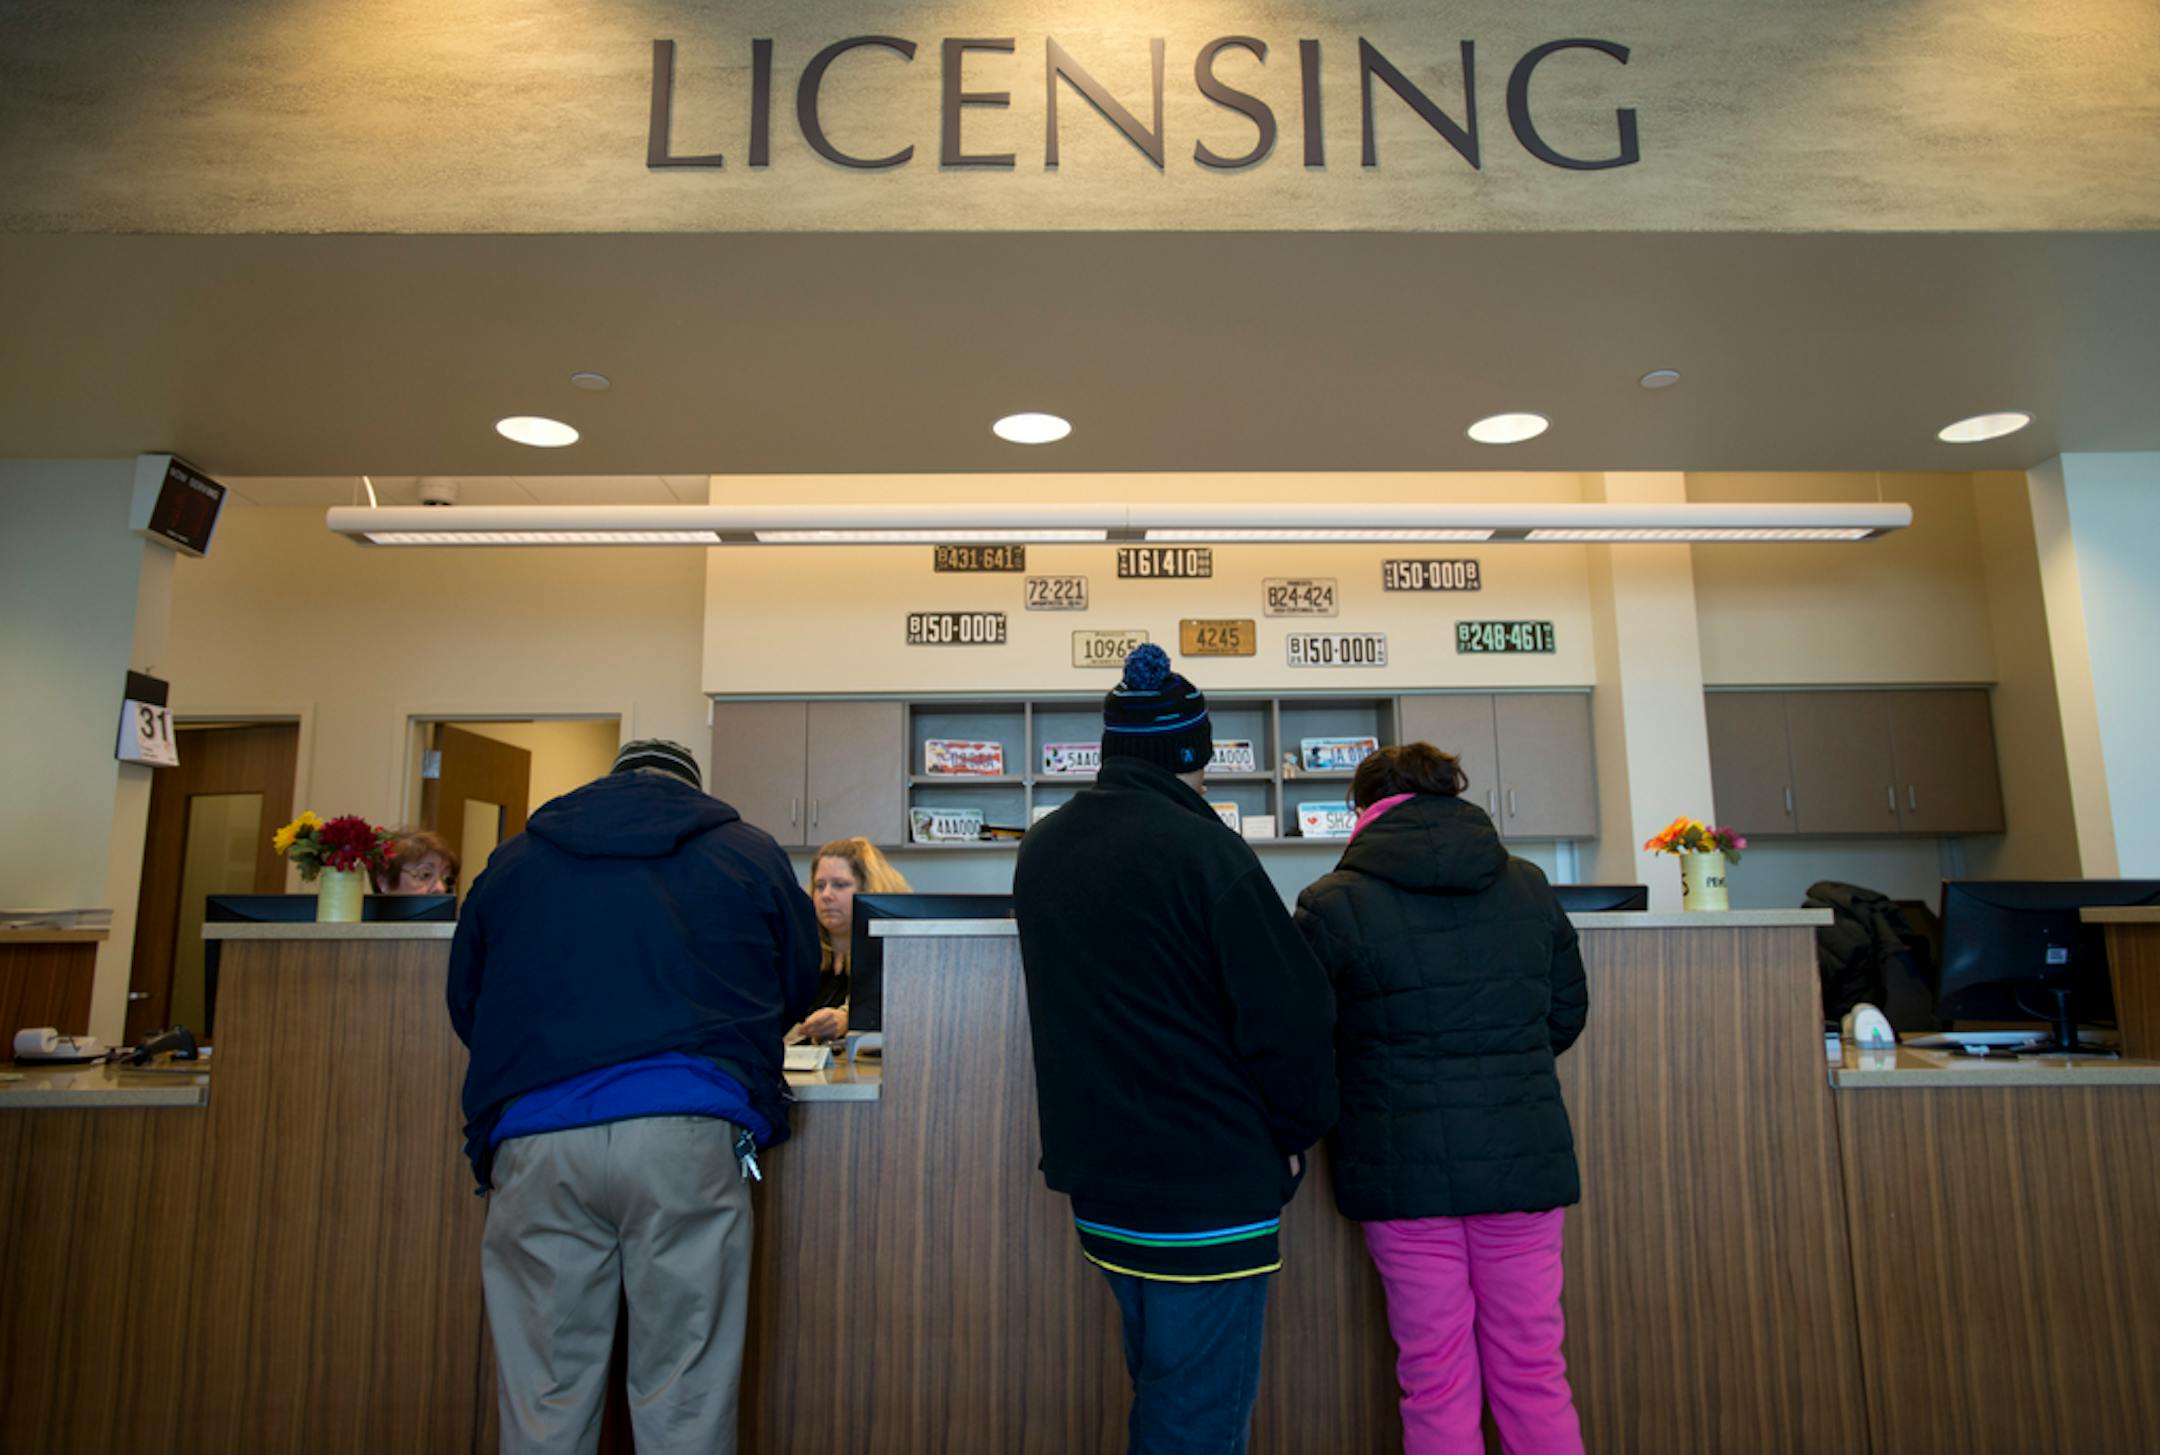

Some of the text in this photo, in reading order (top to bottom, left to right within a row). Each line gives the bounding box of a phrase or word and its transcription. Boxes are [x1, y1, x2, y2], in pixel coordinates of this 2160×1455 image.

[645, 34, 1641, 171] LICENSING
[1196, 627, 1240, 649] 4245
[139, 706, 170, 742] 31
